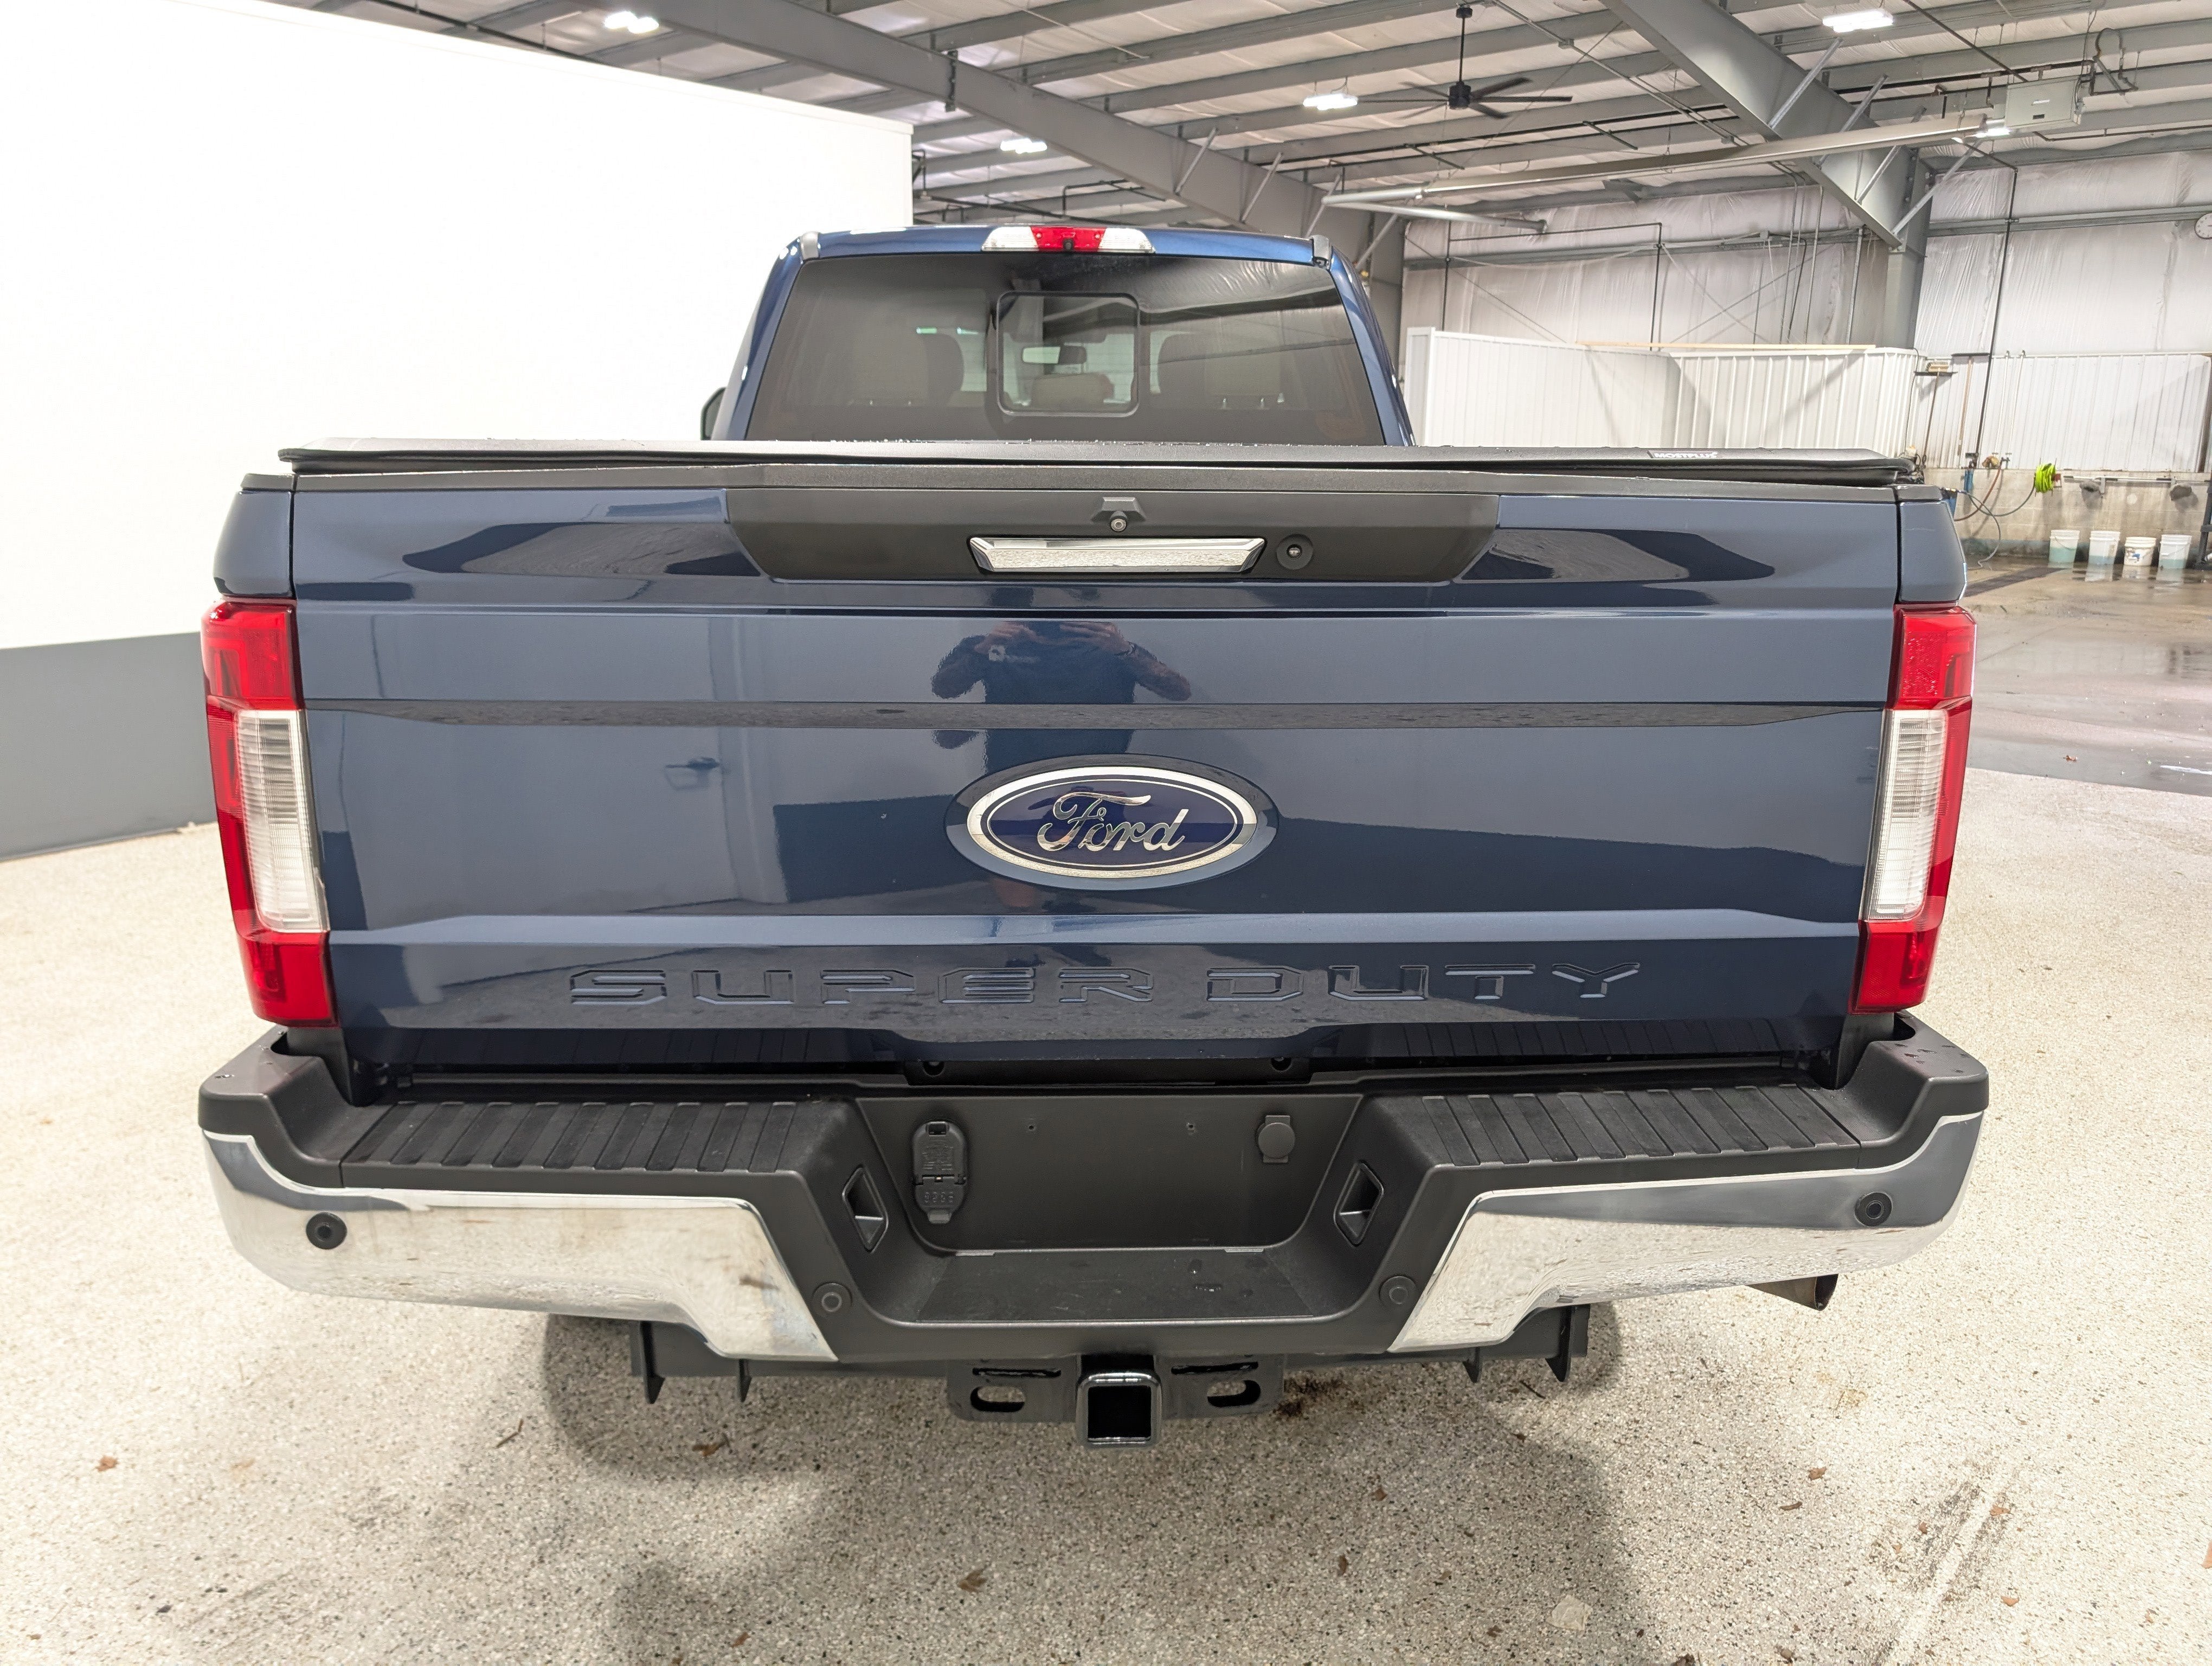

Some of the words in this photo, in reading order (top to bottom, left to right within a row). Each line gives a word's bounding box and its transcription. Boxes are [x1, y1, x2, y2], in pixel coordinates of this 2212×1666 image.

[1037, 791, 1189, 851] Ford
[570, 966, 1153, 1006] SUPER
[1207, 963, 1640, 1002] DUTY
